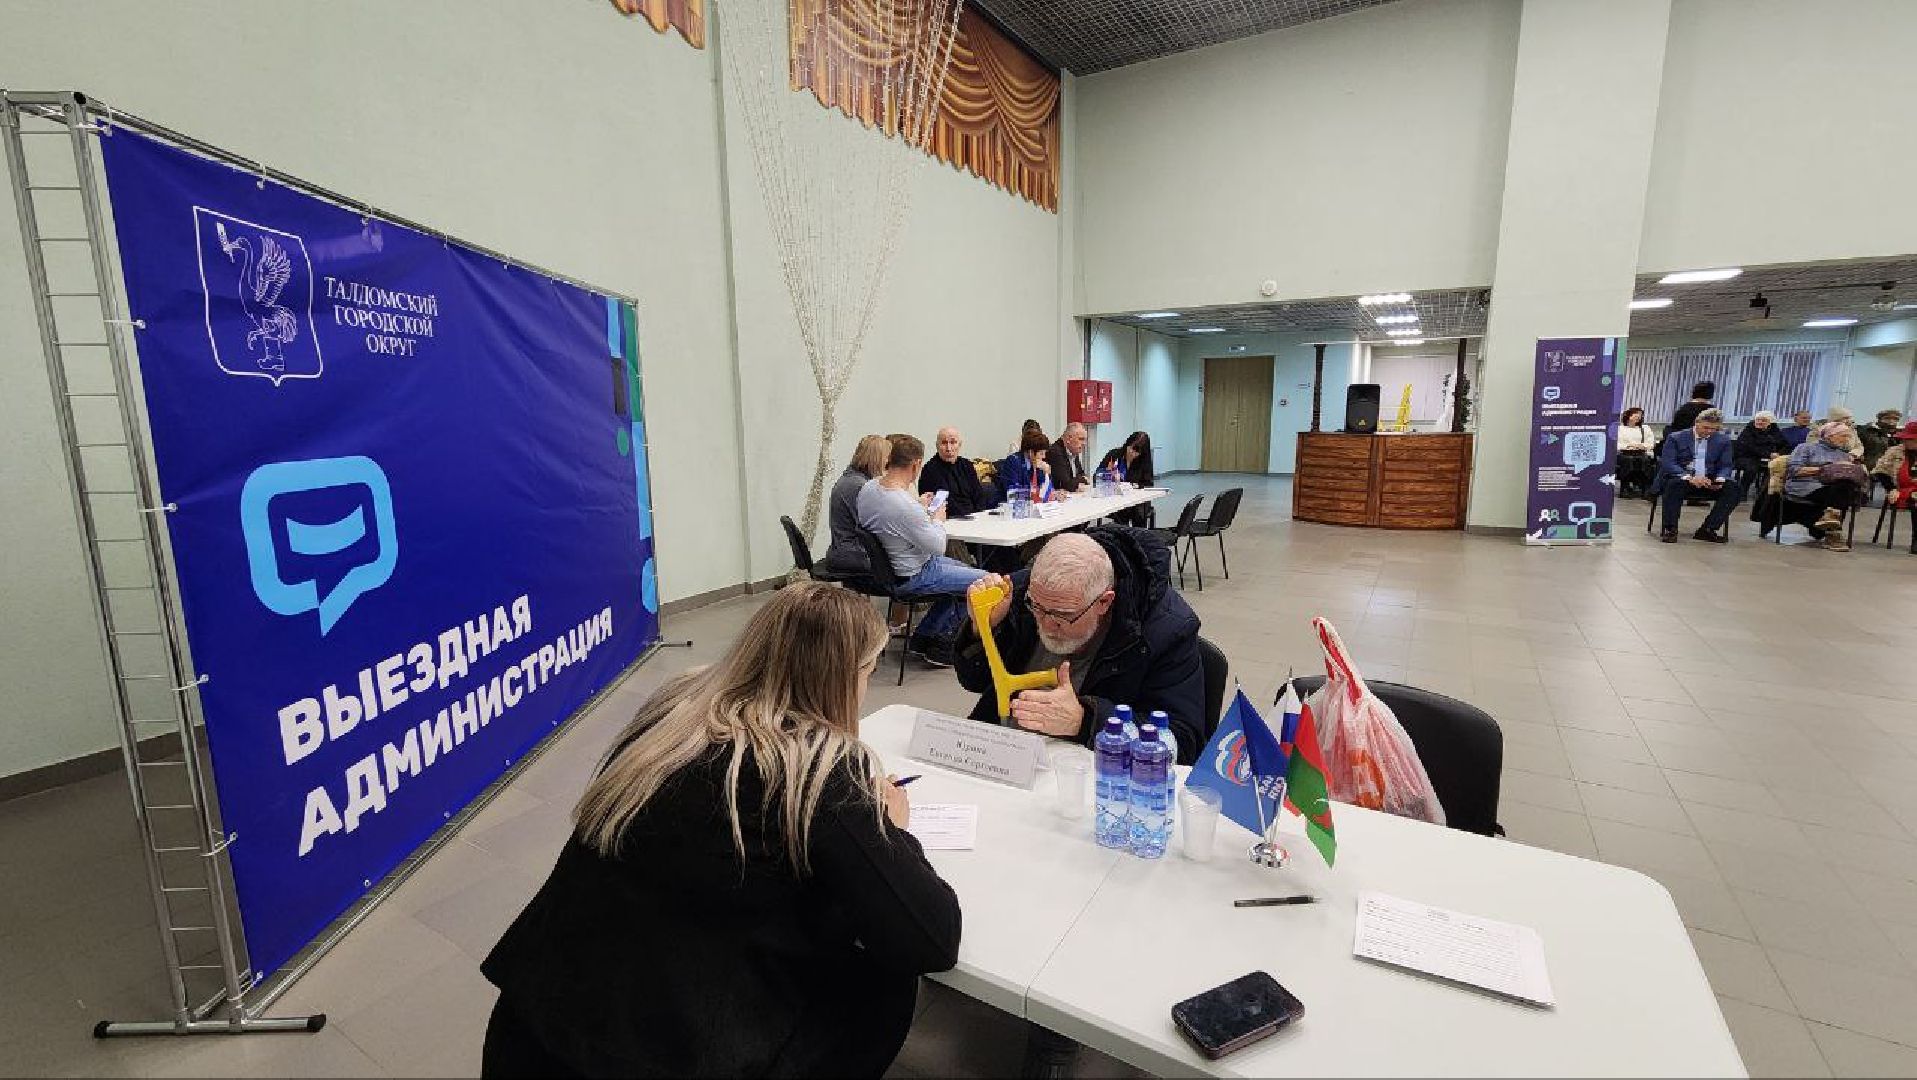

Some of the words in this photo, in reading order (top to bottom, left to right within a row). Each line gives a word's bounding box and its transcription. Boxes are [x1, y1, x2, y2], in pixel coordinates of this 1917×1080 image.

[323, 276, 438, 317] ТАЛДОМСКИЙ
[334, 304, 434, 338] ГОРОДСКОЙ
[365, 333, 417, 357] ОКРУГ
[278, 594, 532, 766] ВЫЕЗДНАЯ
[298, 607, 613, 857] АДМИНИСТРАЦИЯ
